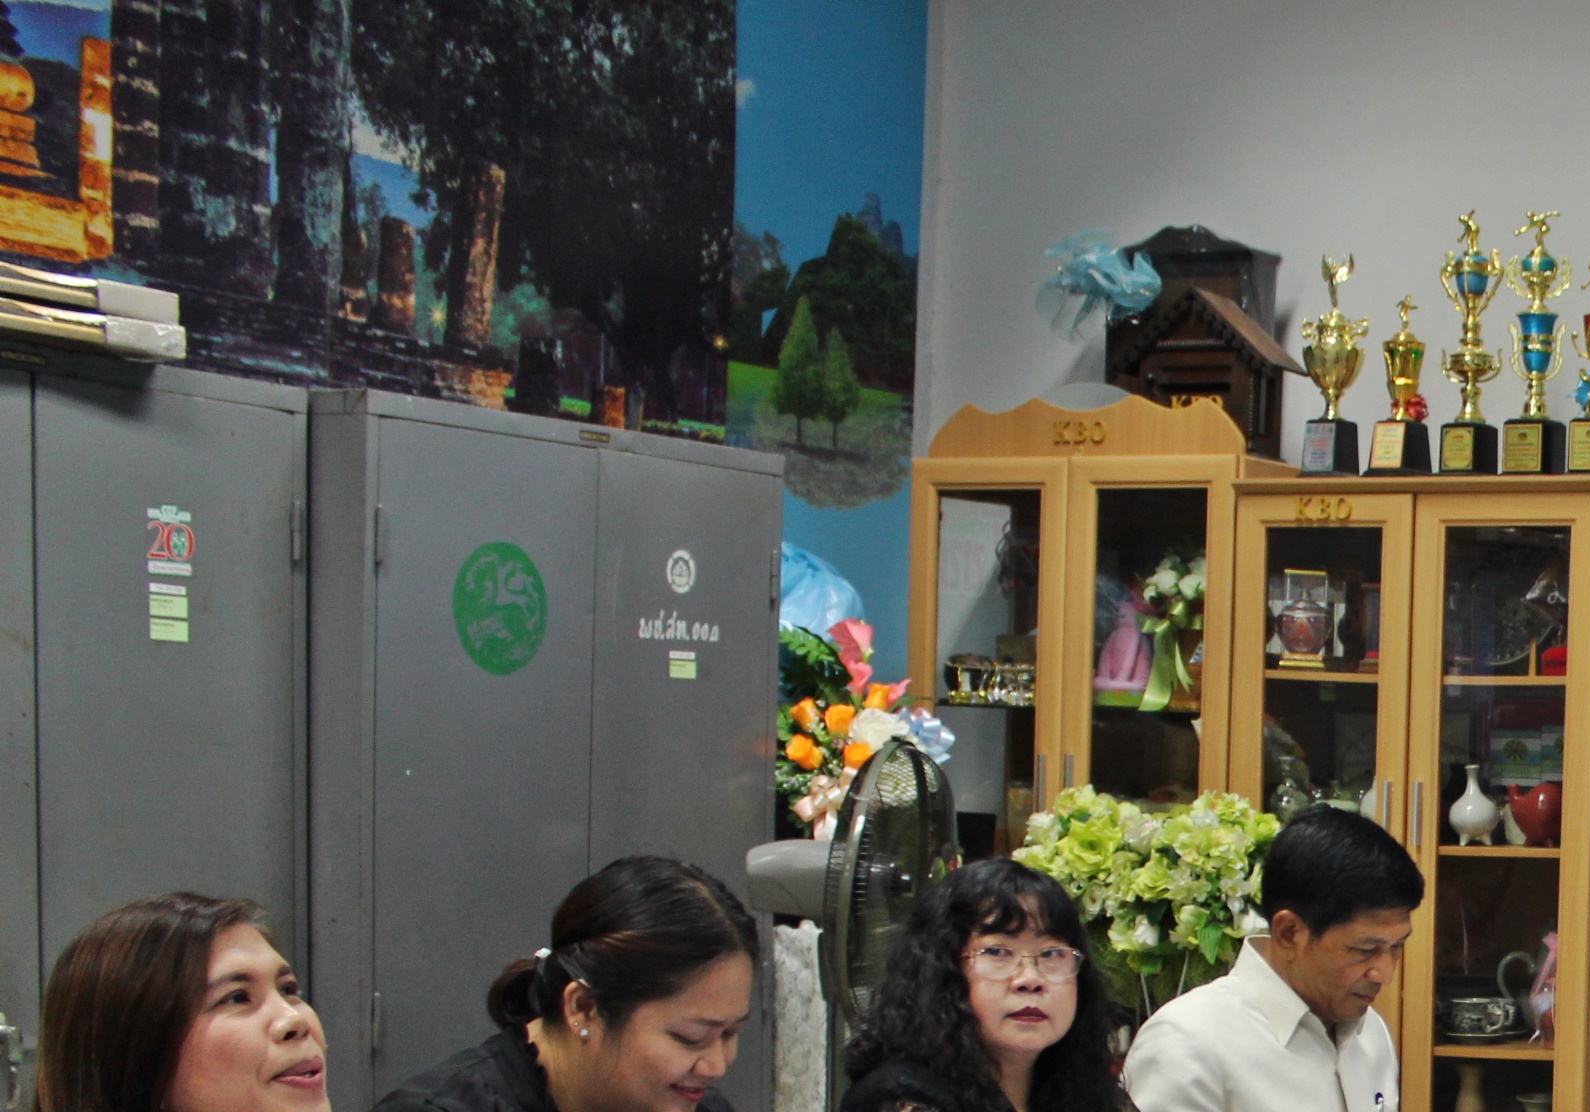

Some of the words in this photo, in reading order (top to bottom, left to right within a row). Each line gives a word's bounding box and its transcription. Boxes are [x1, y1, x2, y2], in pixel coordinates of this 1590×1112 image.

[1053, 421, 1107, 445] KBO
[1295, 497, 1351, 520] KBO
[147, 520, 195, 562] 20
